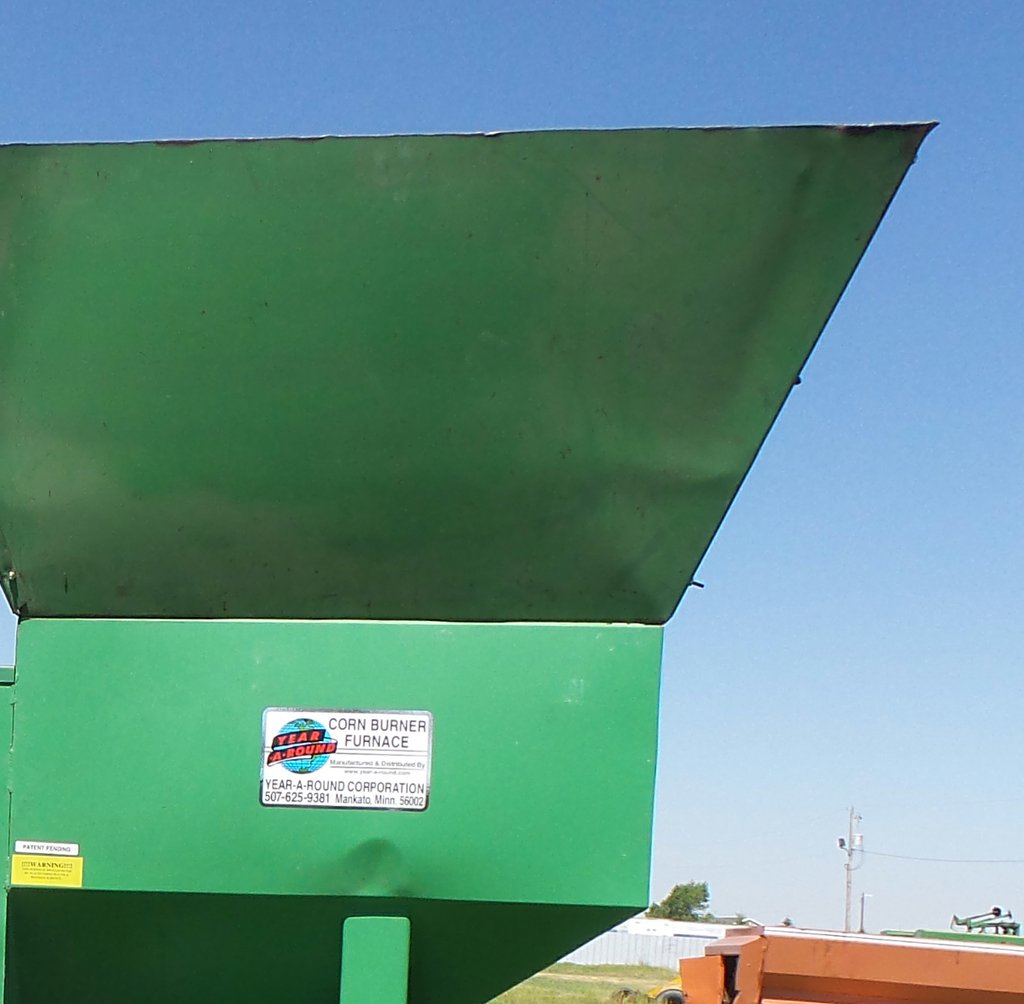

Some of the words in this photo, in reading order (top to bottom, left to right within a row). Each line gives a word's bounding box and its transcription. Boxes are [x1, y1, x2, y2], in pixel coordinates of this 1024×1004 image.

[328, 717, 366, 731] CORN
[371, 719, 426, 732] BURNER
[277, 731, 320, 745] YEAR
[345, 735, 408, 748] FURNACE
[265, 779, 345, 791] YEAR-A-ROUND
[347, 781, 424, 794] CORPORATION
[265, 791, 330, 804] 507-625-9381
[399, 796, 424, 807] 56002
